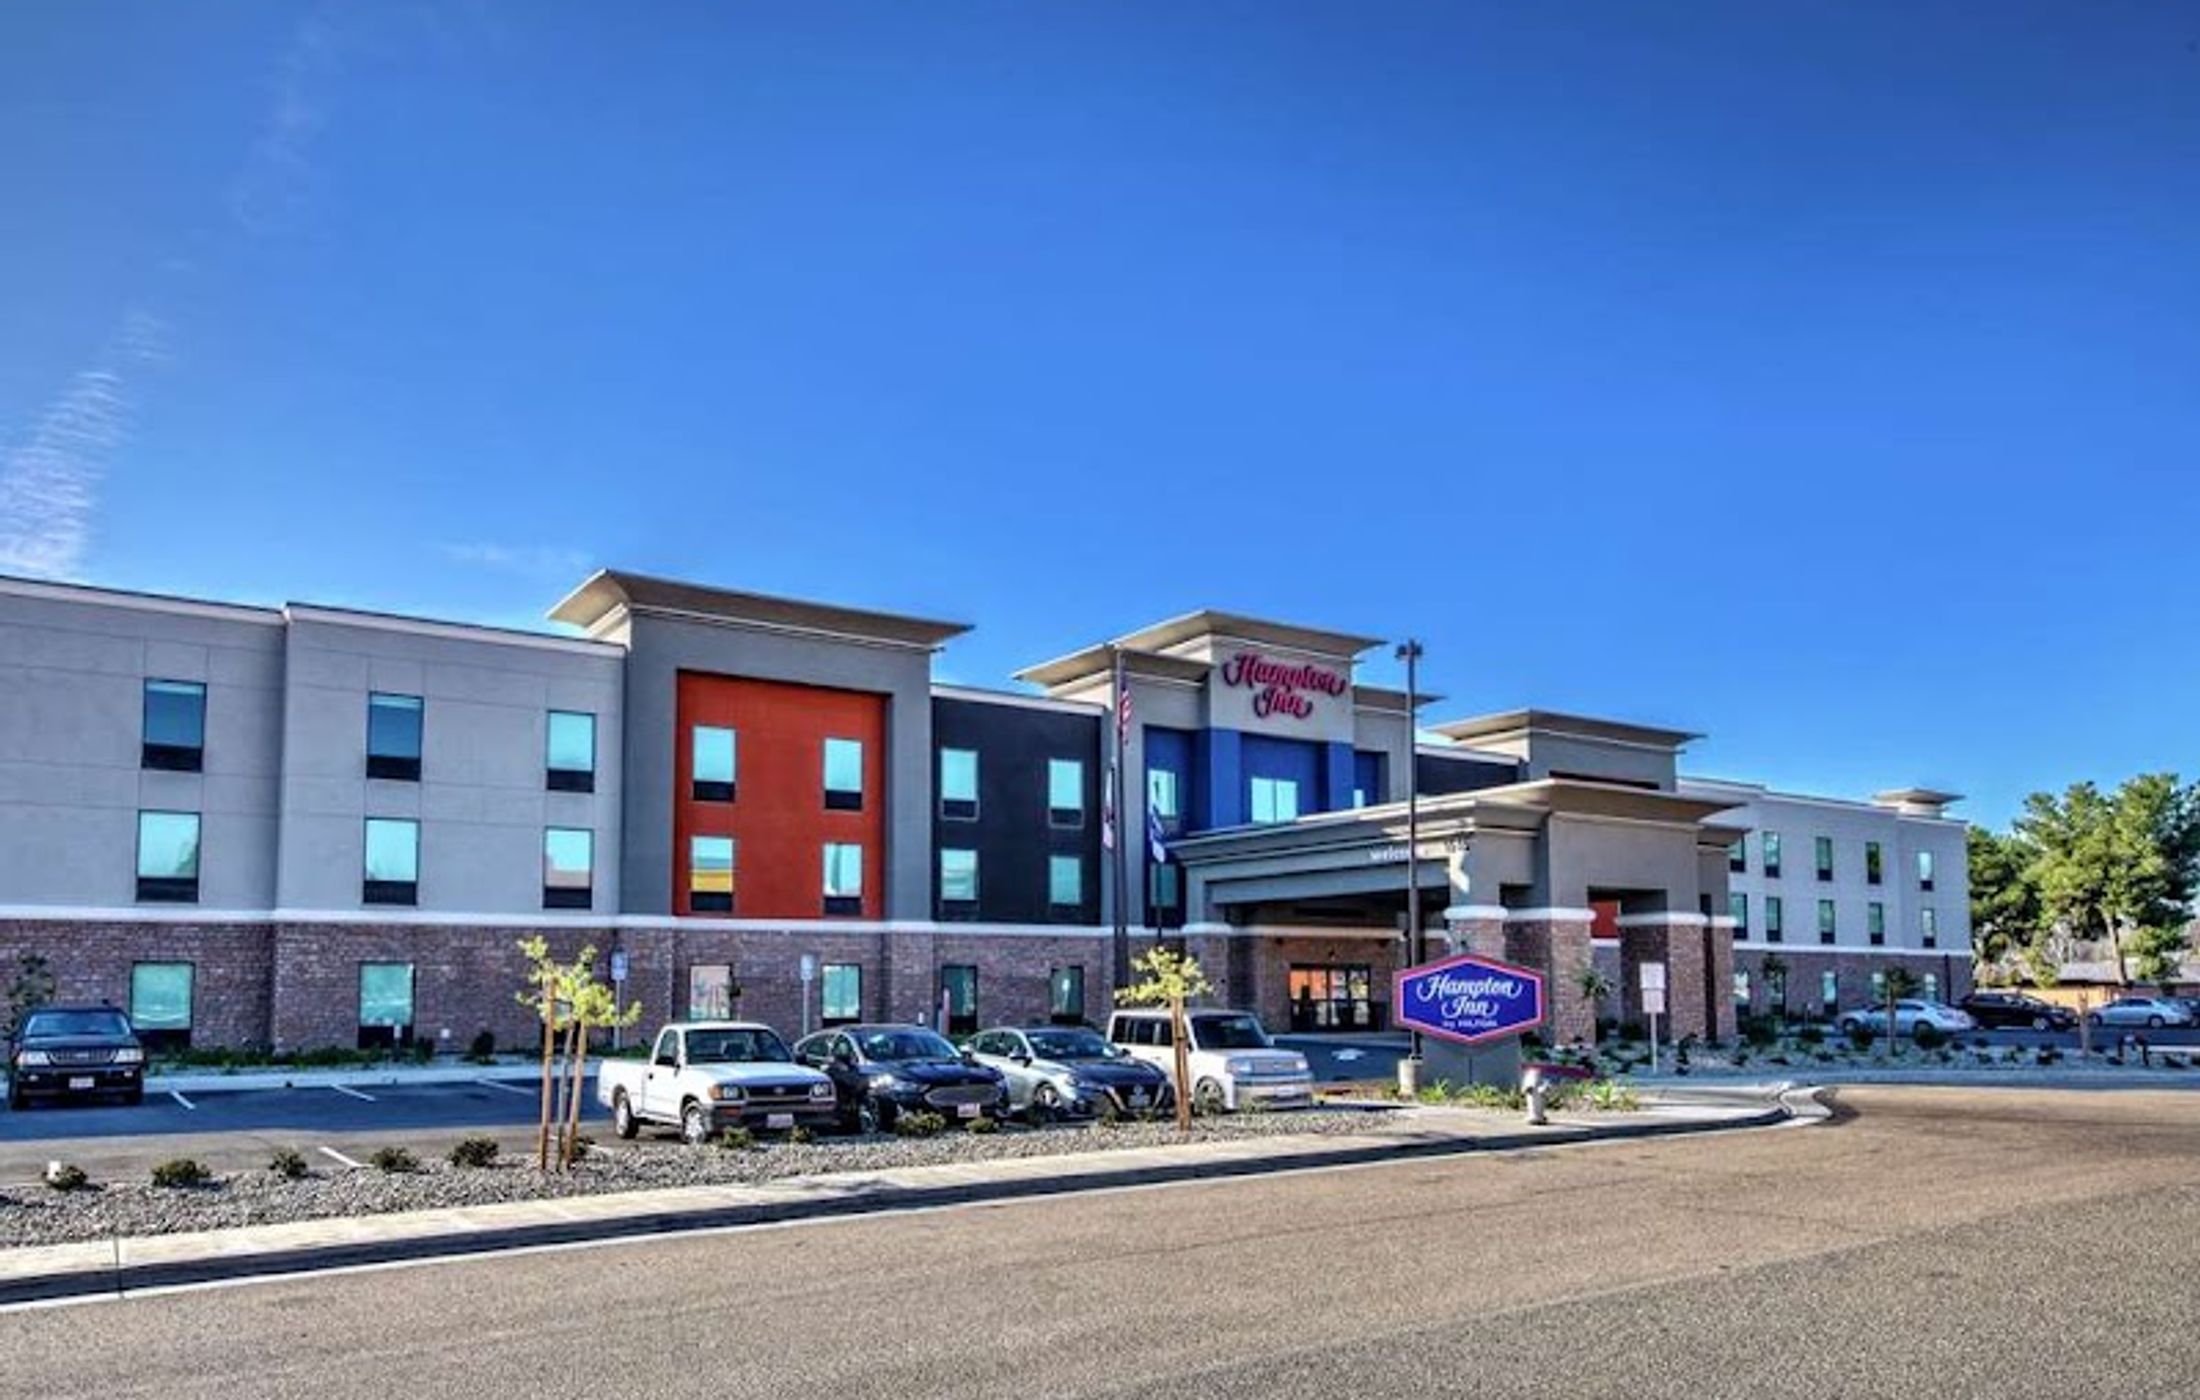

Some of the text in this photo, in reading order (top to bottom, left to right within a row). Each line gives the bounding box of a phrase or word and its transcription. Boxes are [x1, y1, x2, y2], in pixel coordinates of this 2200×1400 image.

[1222, 653, 1346, 696] Hampton
[1253, 687, 1313, 718] Inn
[1416, 974, 1522, 1001] Hampton
[1441, 995, 1498, 1018] Inn
